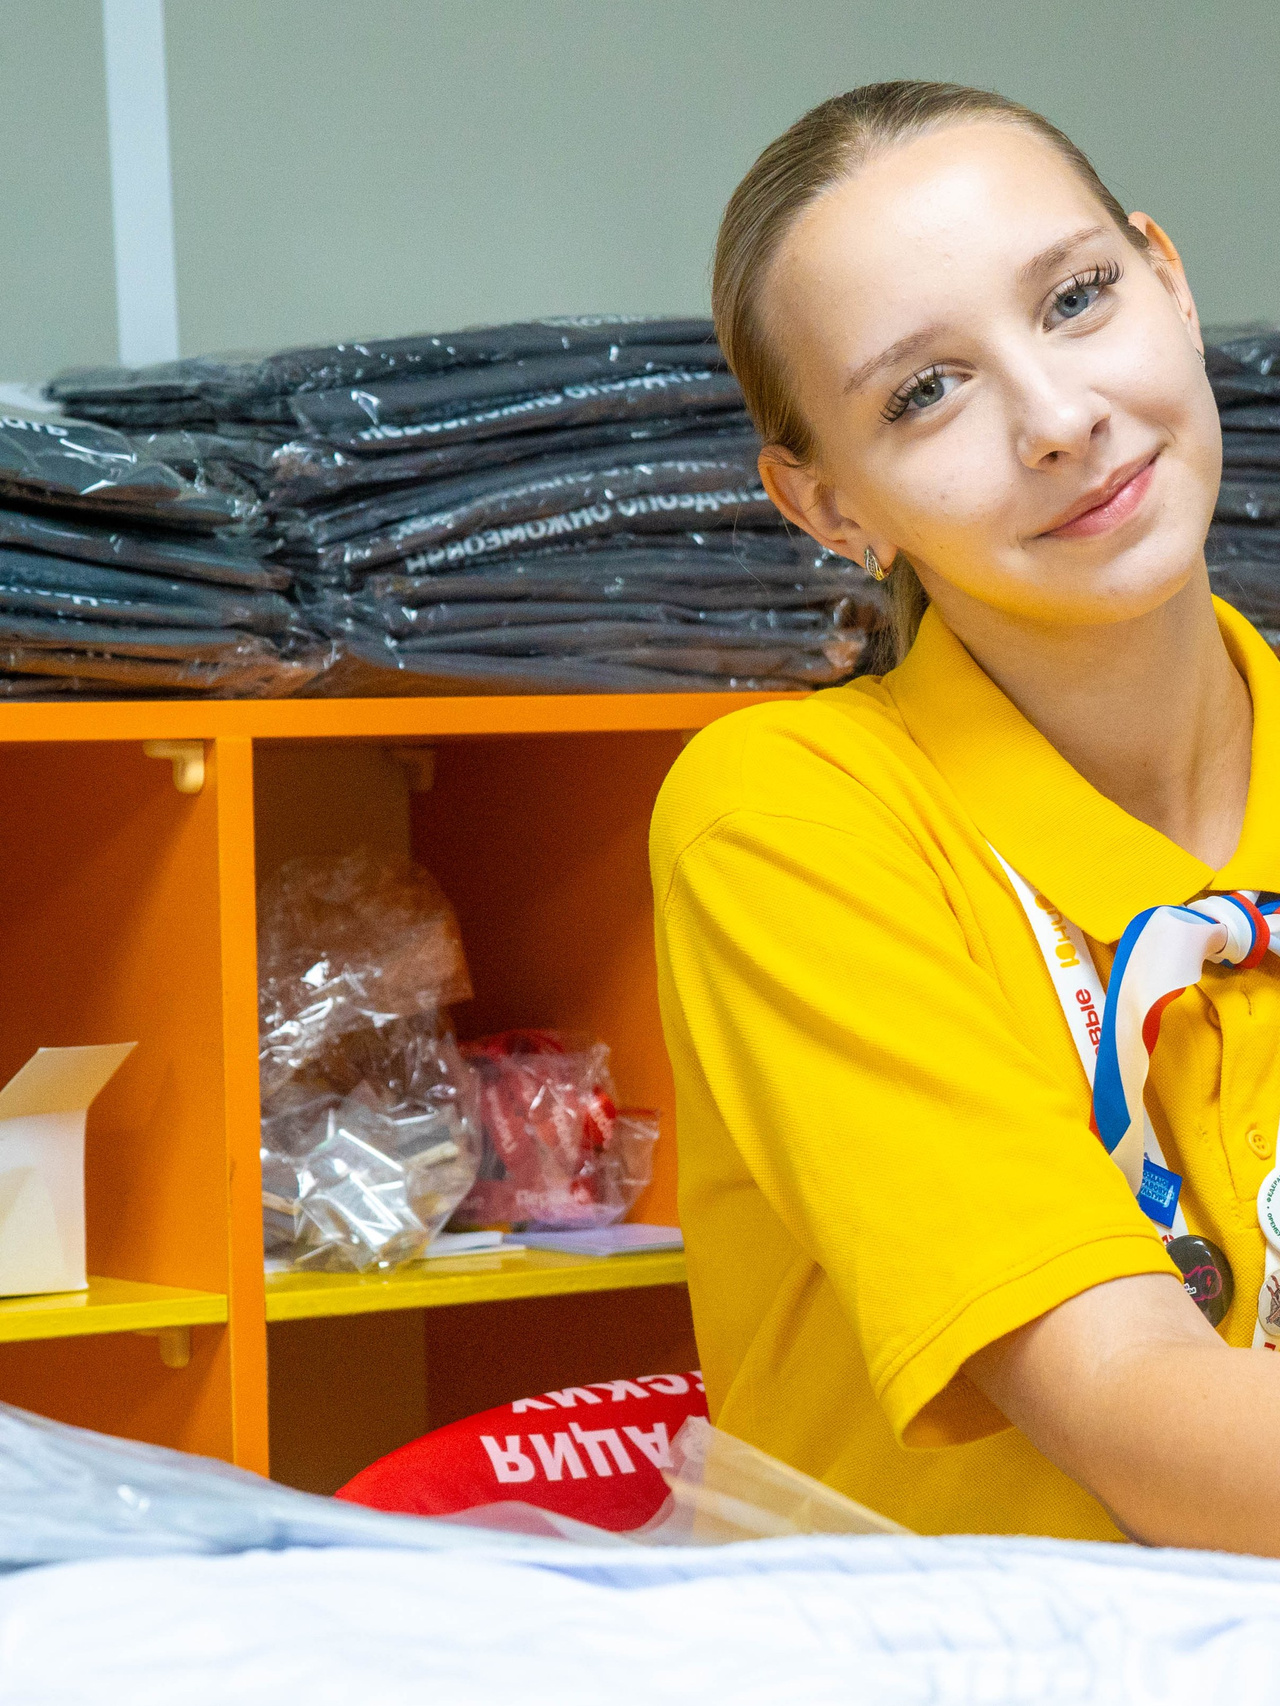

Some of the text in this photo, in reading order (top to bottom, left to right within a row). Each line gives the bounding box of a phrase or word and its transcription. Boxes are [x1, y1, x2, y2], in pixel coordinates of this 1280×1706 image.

[1075, 988, 1101, 1056] вые
[1143, 1170, 1168, 1186] ОЗДАЮ
[511, 1370, 706, 1414] СКИХ
[480, 1421, 673, 1484] АЦИЯ
